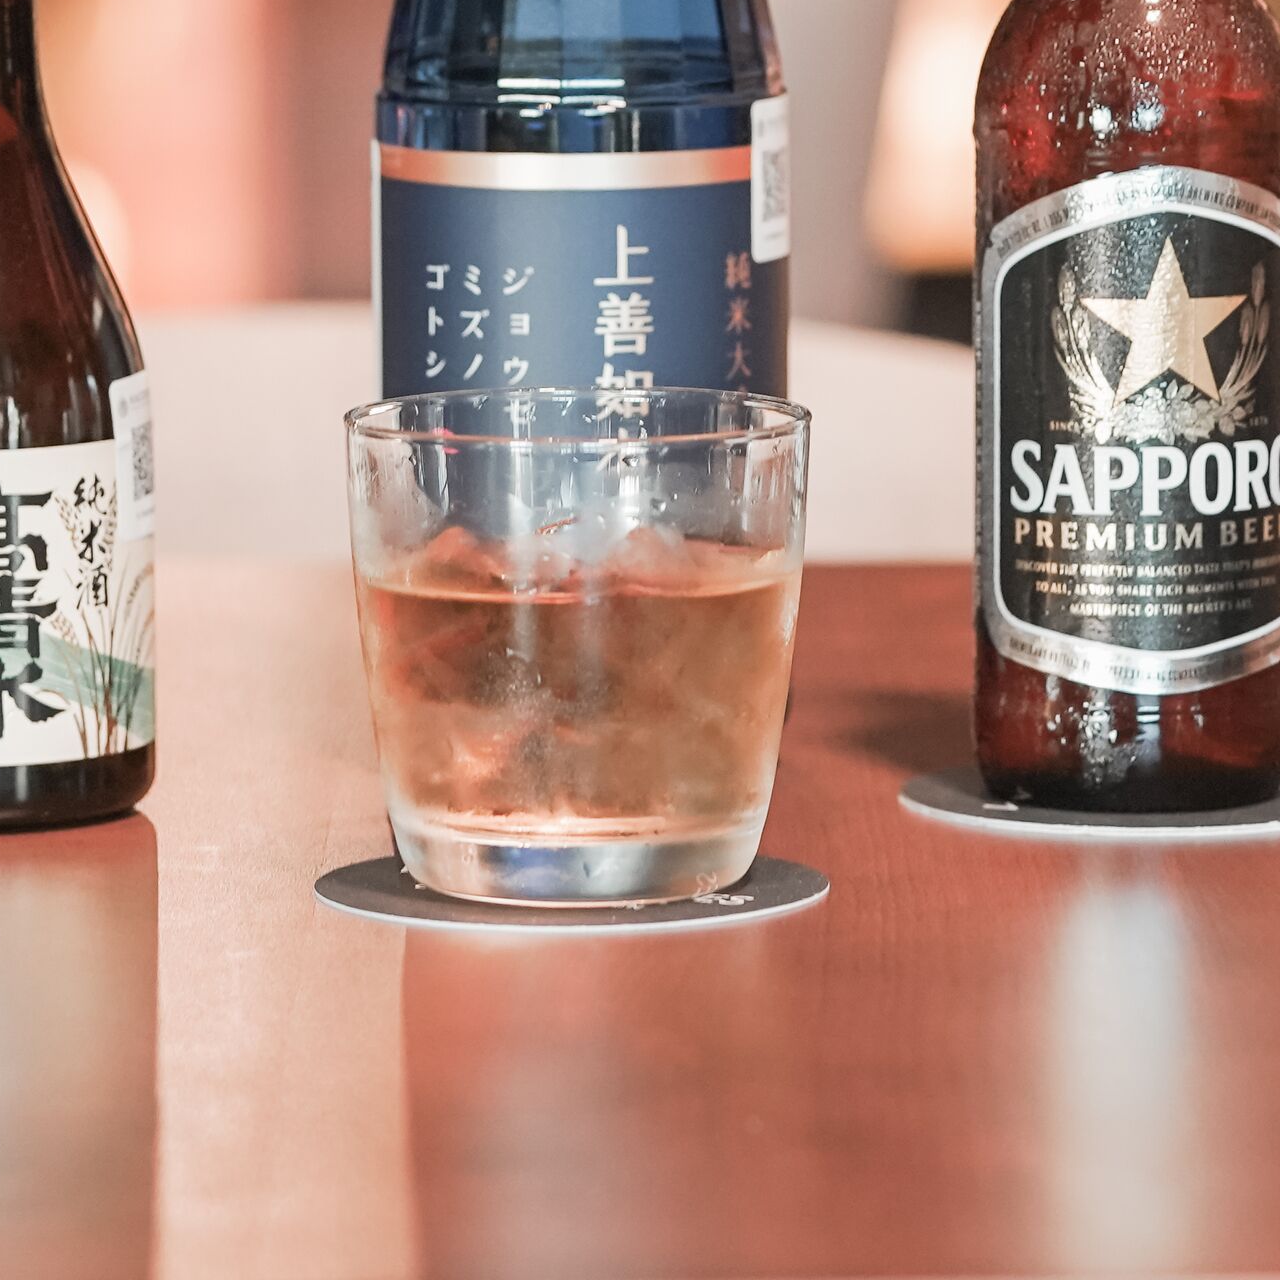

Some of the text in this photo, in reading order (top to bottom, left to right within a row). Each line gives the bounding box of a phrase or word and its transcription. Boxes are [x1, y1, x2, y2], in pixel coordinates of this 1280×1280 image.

[426, 263, 451, 379] ゴトシ
[460, 265, 490, 381] ミズノ
[725, 251, 752, 395] 純米大
[1014, 516, 1204, 551] PREMIUM
[1036, 580, 1049, 592] TO
[1155, 584, 1183, 597] RICH
[1144, 603, 1160, 617] OF
